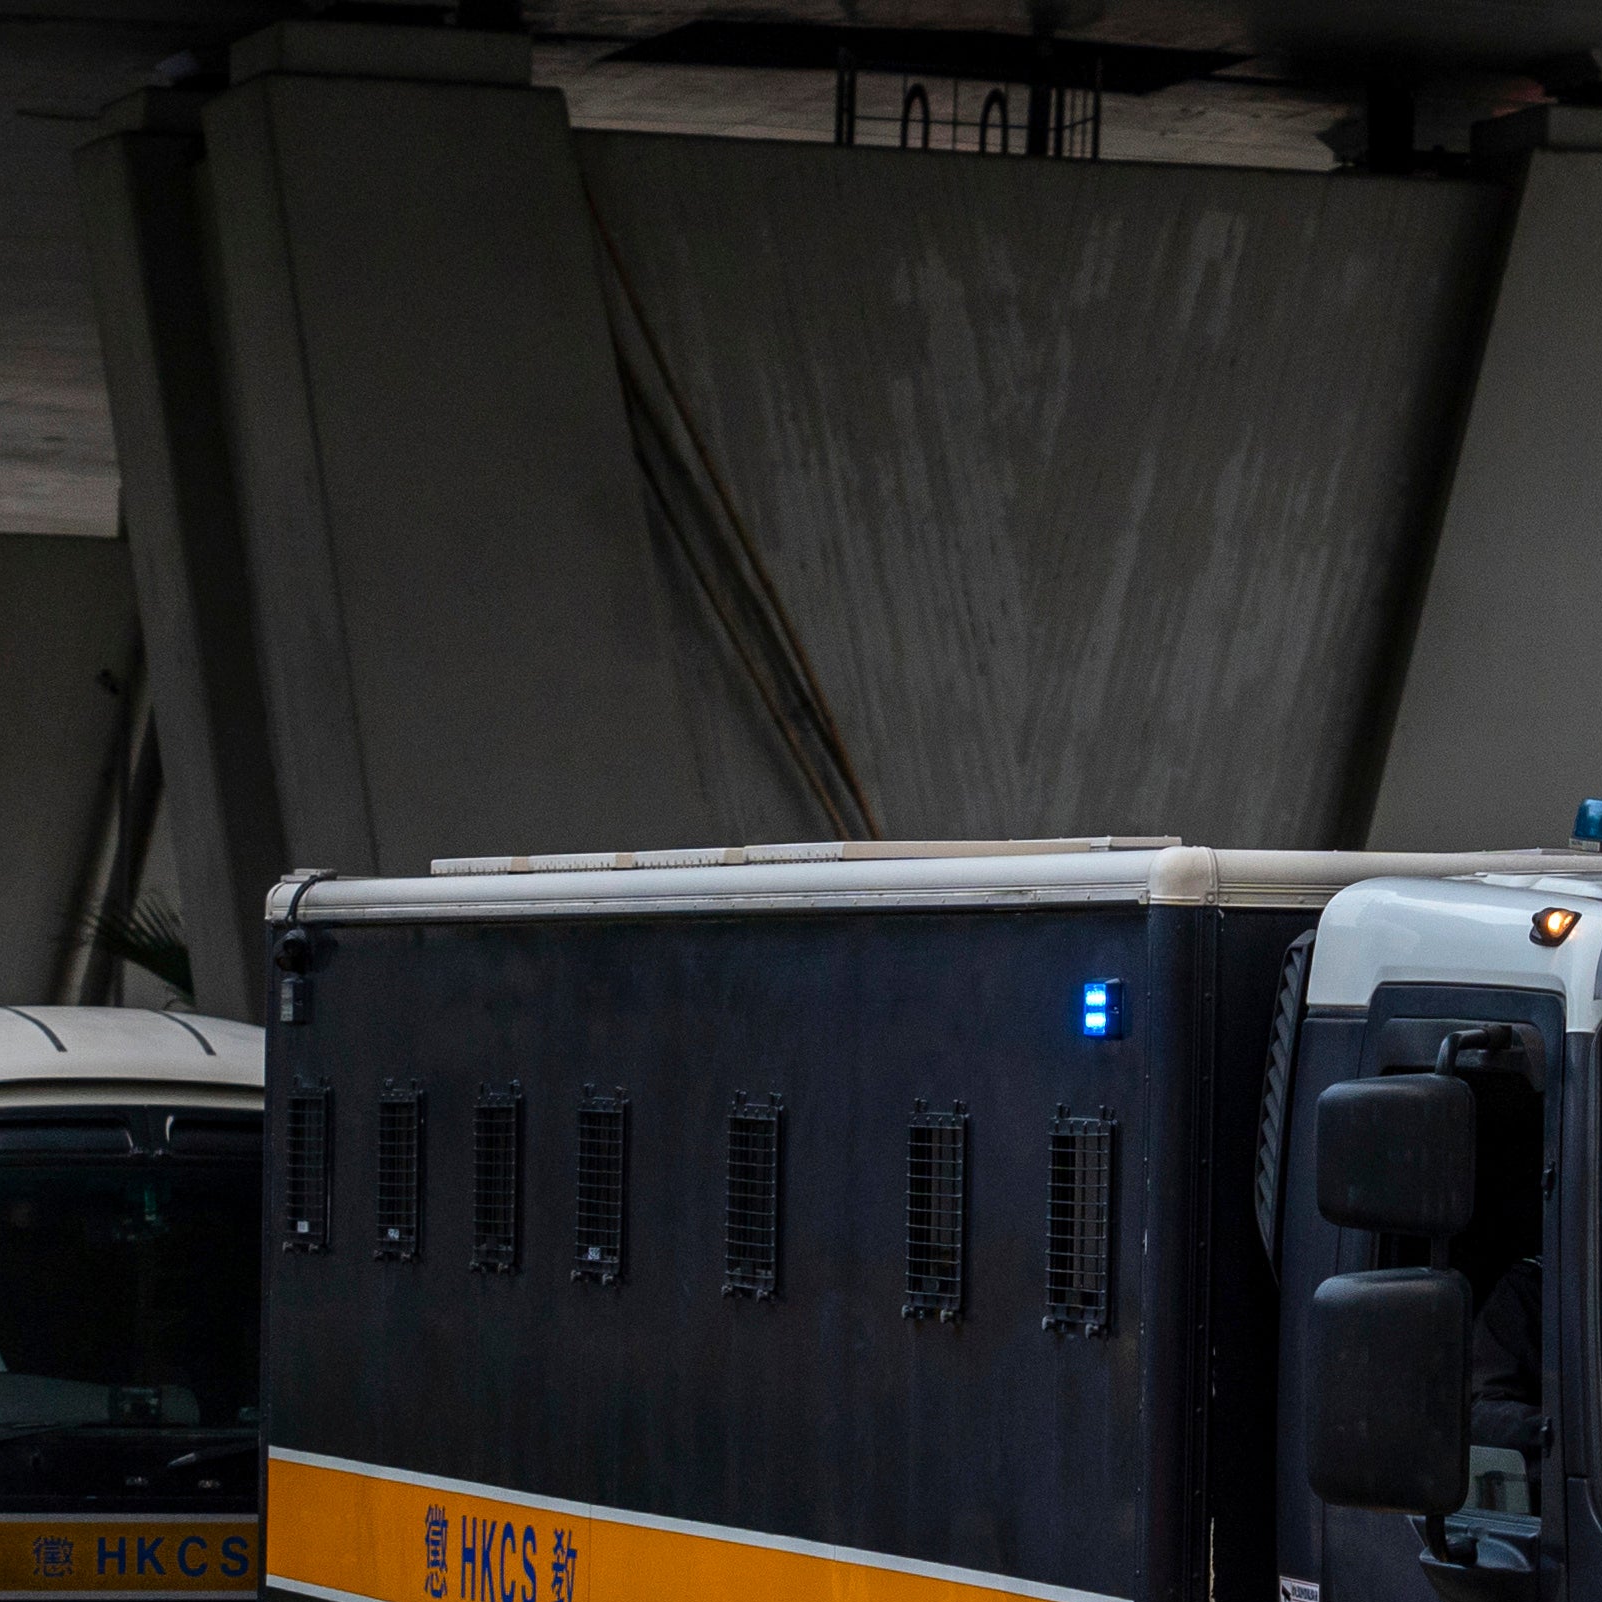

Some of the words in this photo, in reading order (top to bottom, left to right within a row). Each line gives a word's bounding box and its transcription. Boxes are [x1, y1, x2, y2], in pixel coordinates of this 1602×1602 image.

[32, 1535, 75, 1578] 懲
[96, 1535, 250, 1578] HKCS
[424, 1503, 449, 1599] 懲
